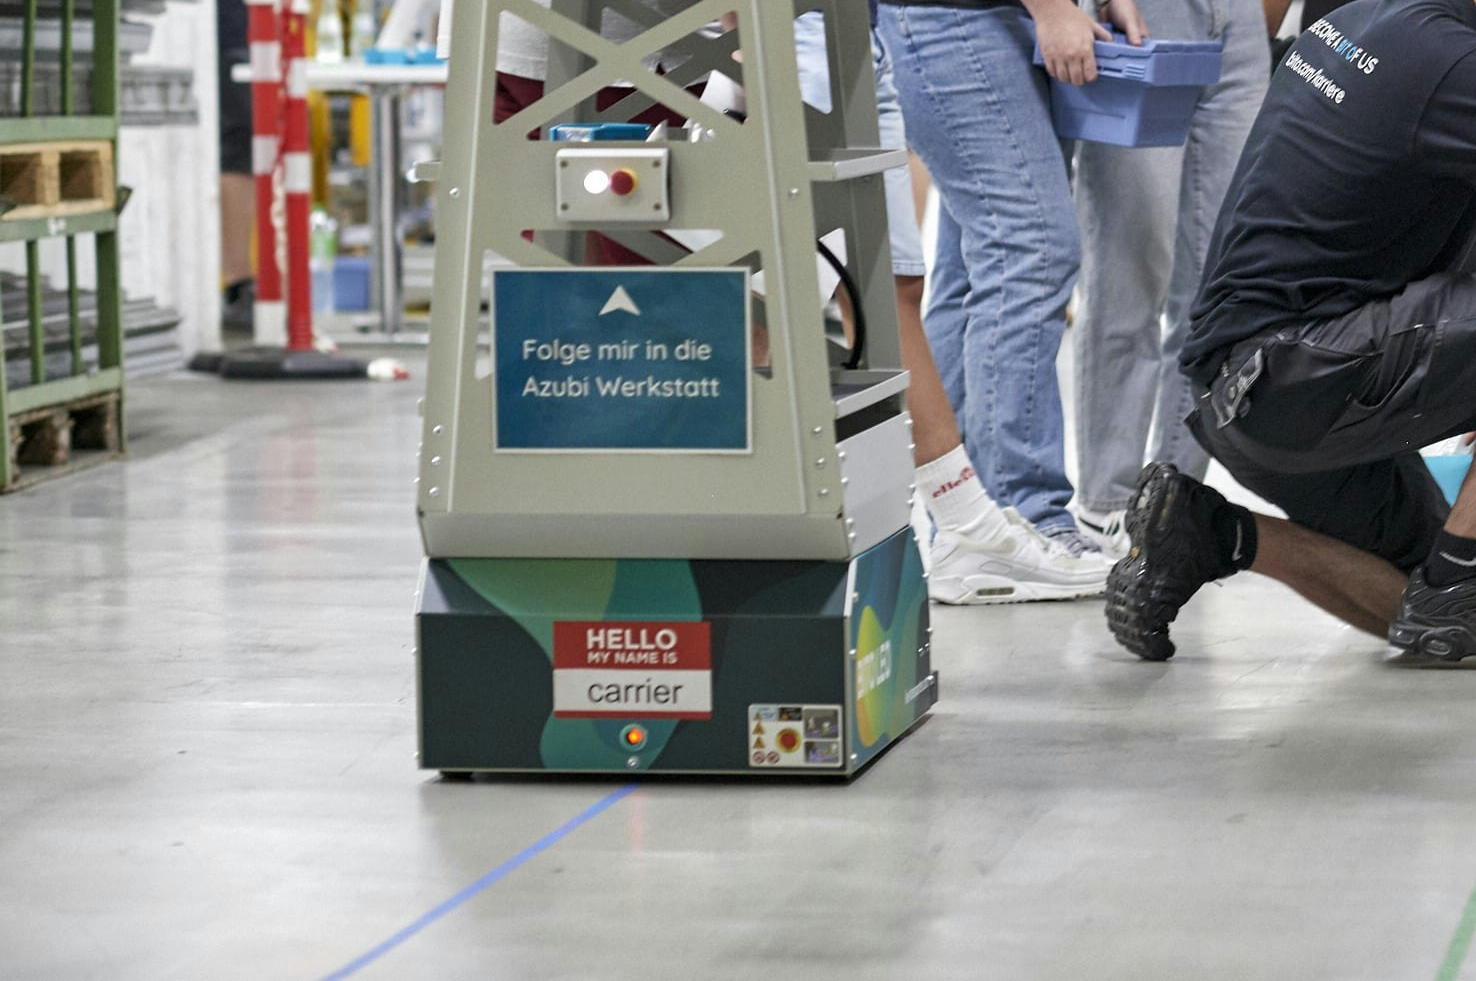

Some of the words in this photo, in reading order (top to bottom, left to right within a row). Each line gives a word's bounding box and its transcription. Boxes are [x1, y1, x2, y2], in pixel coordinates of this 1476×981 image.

[1357, 52, 1379, 74] US
[523, 338, 591, 365] Folge
[598, 339, 639, 360] mir
[645, 339, 668, 360] in
[674, 338, 712, 360] die
[521, 376, 590, 397] Azubi
[595, 376, 720, 397] Werkstatt
[586, 628, 677, 650] HELLO
[587, 651, 610, 664] MY
[614, 651, 658, 664] NAME
[662, 651, 678, 664] IS
[587, 678, 683, 704] carrier
